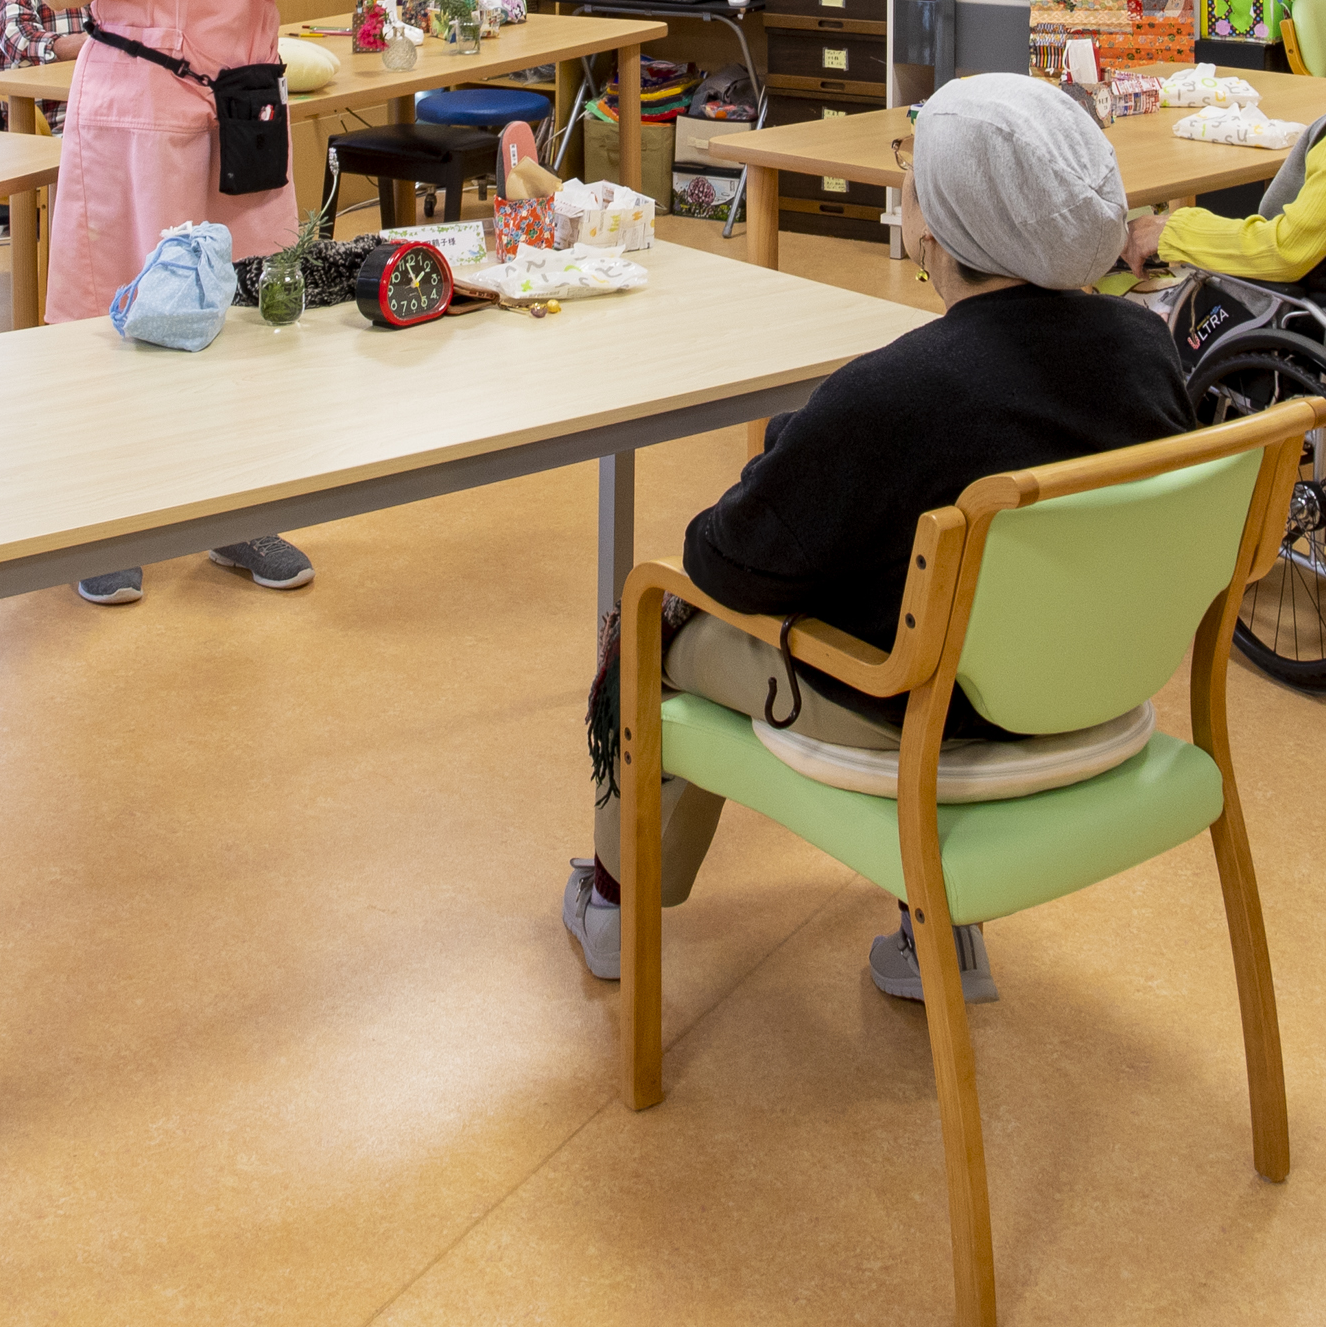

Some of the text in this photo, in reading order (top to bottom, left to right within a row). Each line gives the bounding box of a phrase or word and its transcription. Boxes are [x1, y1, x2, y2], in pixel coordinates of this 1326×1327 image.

[398, 260, 405, 271] 11
[406, 254, 415, 266] 12
[418, 254, 422, 266] 1
[424, 261, 431, 272] 2
[392, 272, 400, 283] 10
[431, 274, 438, 285] 3
[388, 285, 394, 297] 9
[430, 288, 437, 299] 4
[391, 299, 397, 310] 8
[401, 301, 407, 313] 7
[411, 299, 418, 310] 6
[421, 296, 428, 307] 5
[1187, 308, 1229, 350] ULTRA
